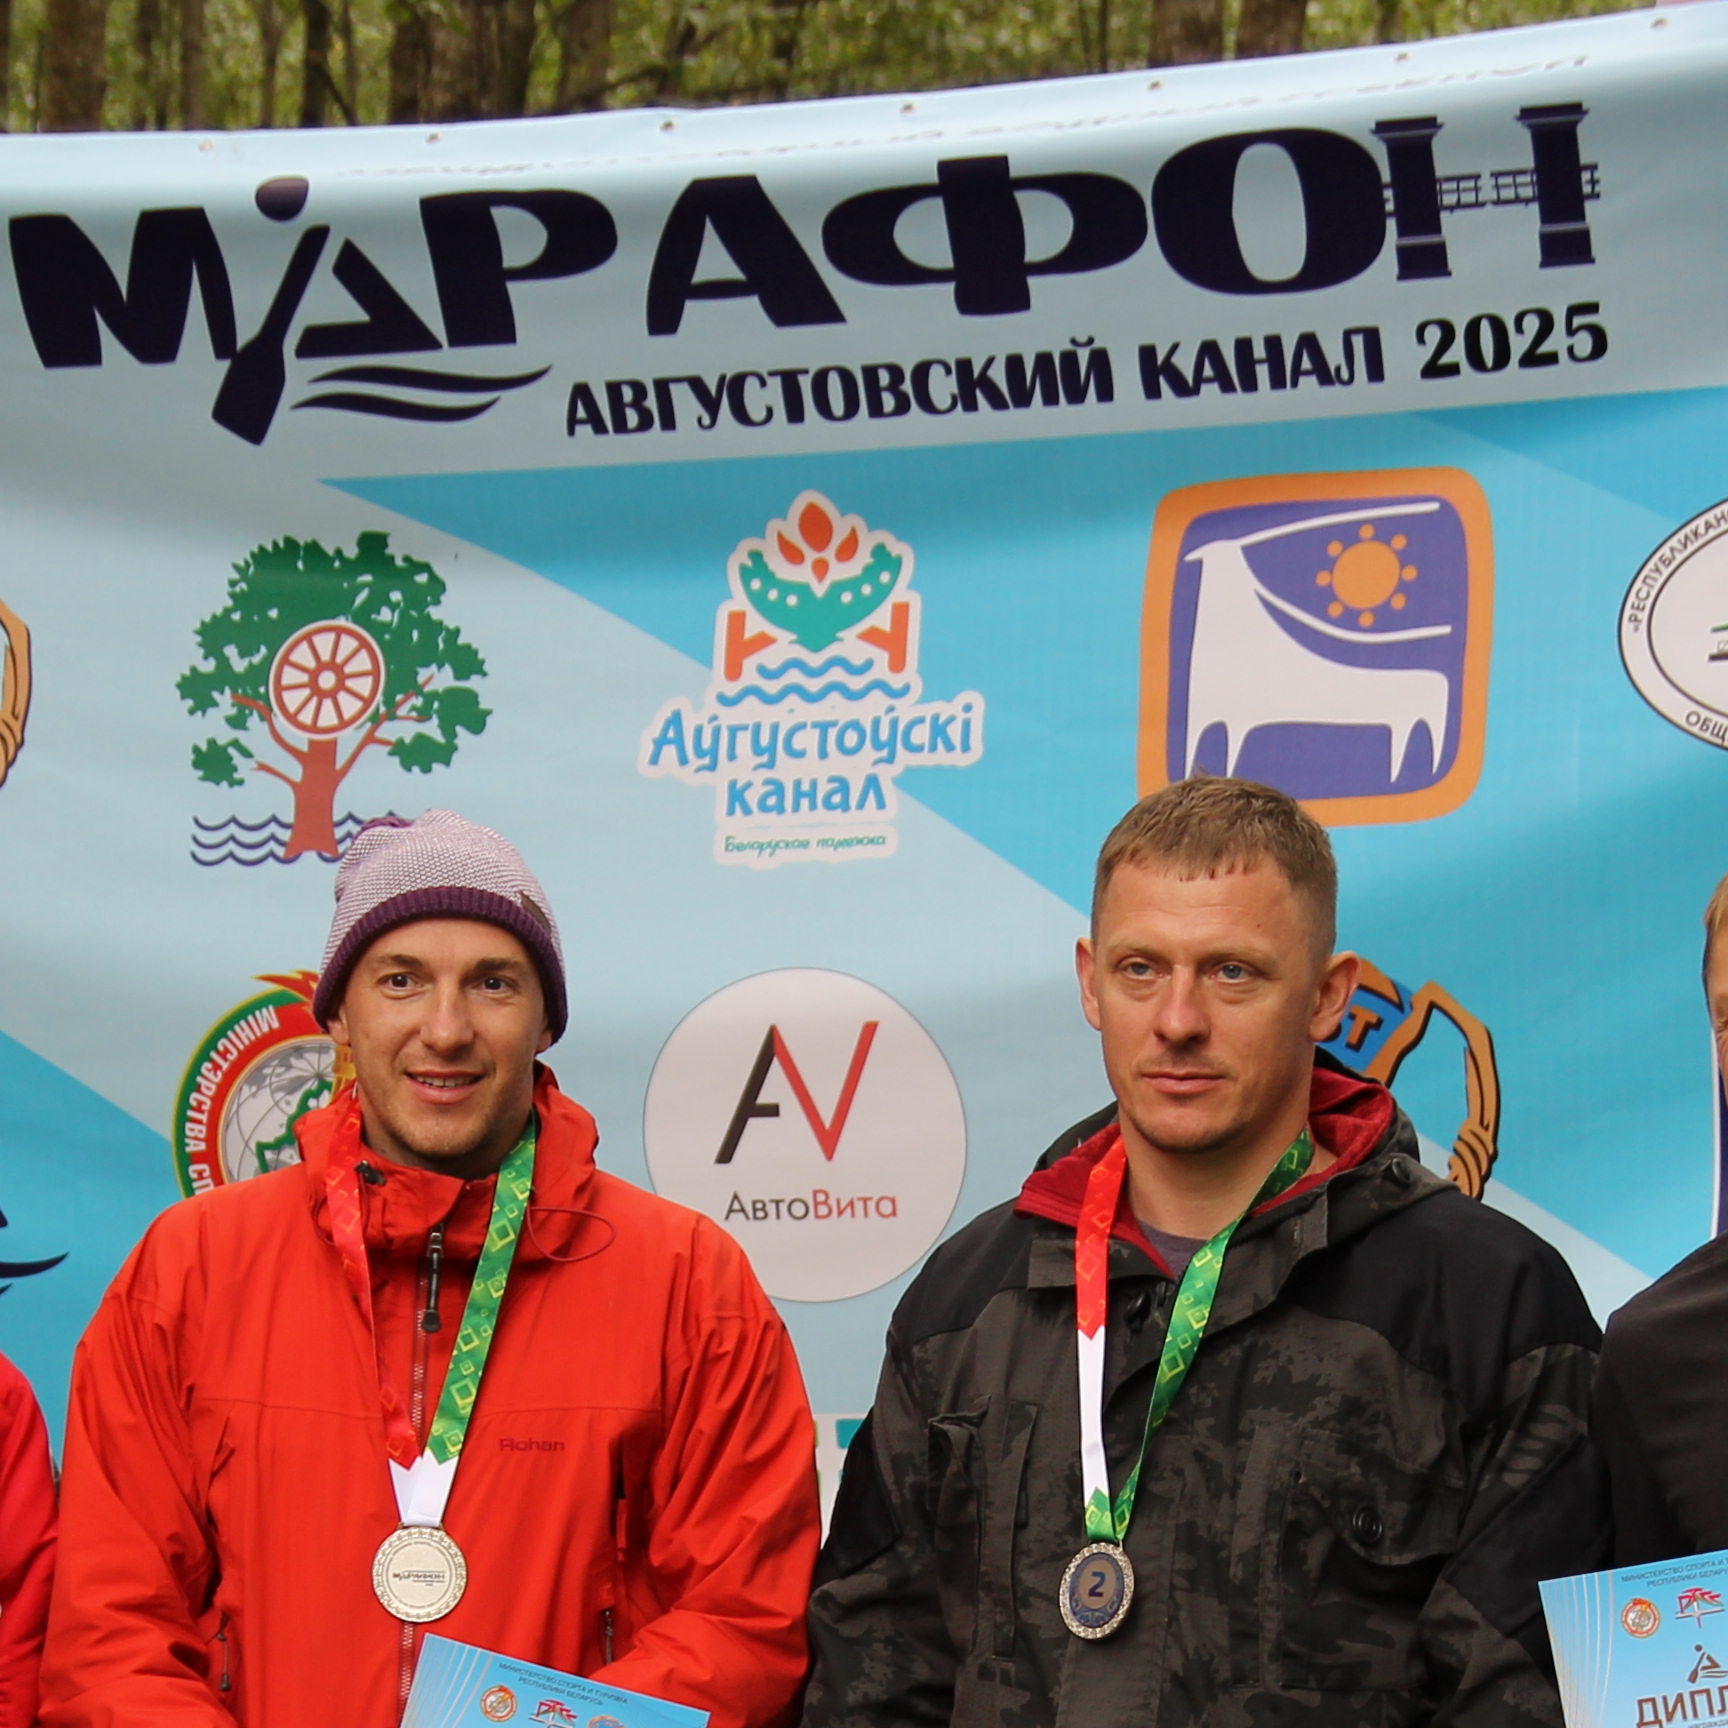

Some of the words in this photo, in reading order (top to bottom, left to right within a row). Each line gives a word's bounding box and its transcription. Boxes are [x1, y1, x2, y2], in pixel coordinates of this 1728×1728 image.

[9, 102, 1600, 447] МАРАФОН
[565, 335, 1114, 437] АВГУСТОВСКИЙ
[1138, 325, 1385, 402] КАНАЛ
[1415, 300, 1610, 382] 2025
[649, 703, 973, 773] Аўгустоўскі
[726, 773, 886, 817] канал
[184, 1004, 281, 1153] МІНІСТЭРСТВА
[724, 1189, 897, 1222] АвтоВита
[499, 1437, 565, 1452] Rohan
[1088, 1571, 1107, 1598] 2
[1621, 1565, 1684, 1582] МИНИСТЕРСТВО
[1685, 1560, 1715, 1571] СПОРТА
[1646, 1572, 1697, 1587] РЕСПУБЛИКИ
